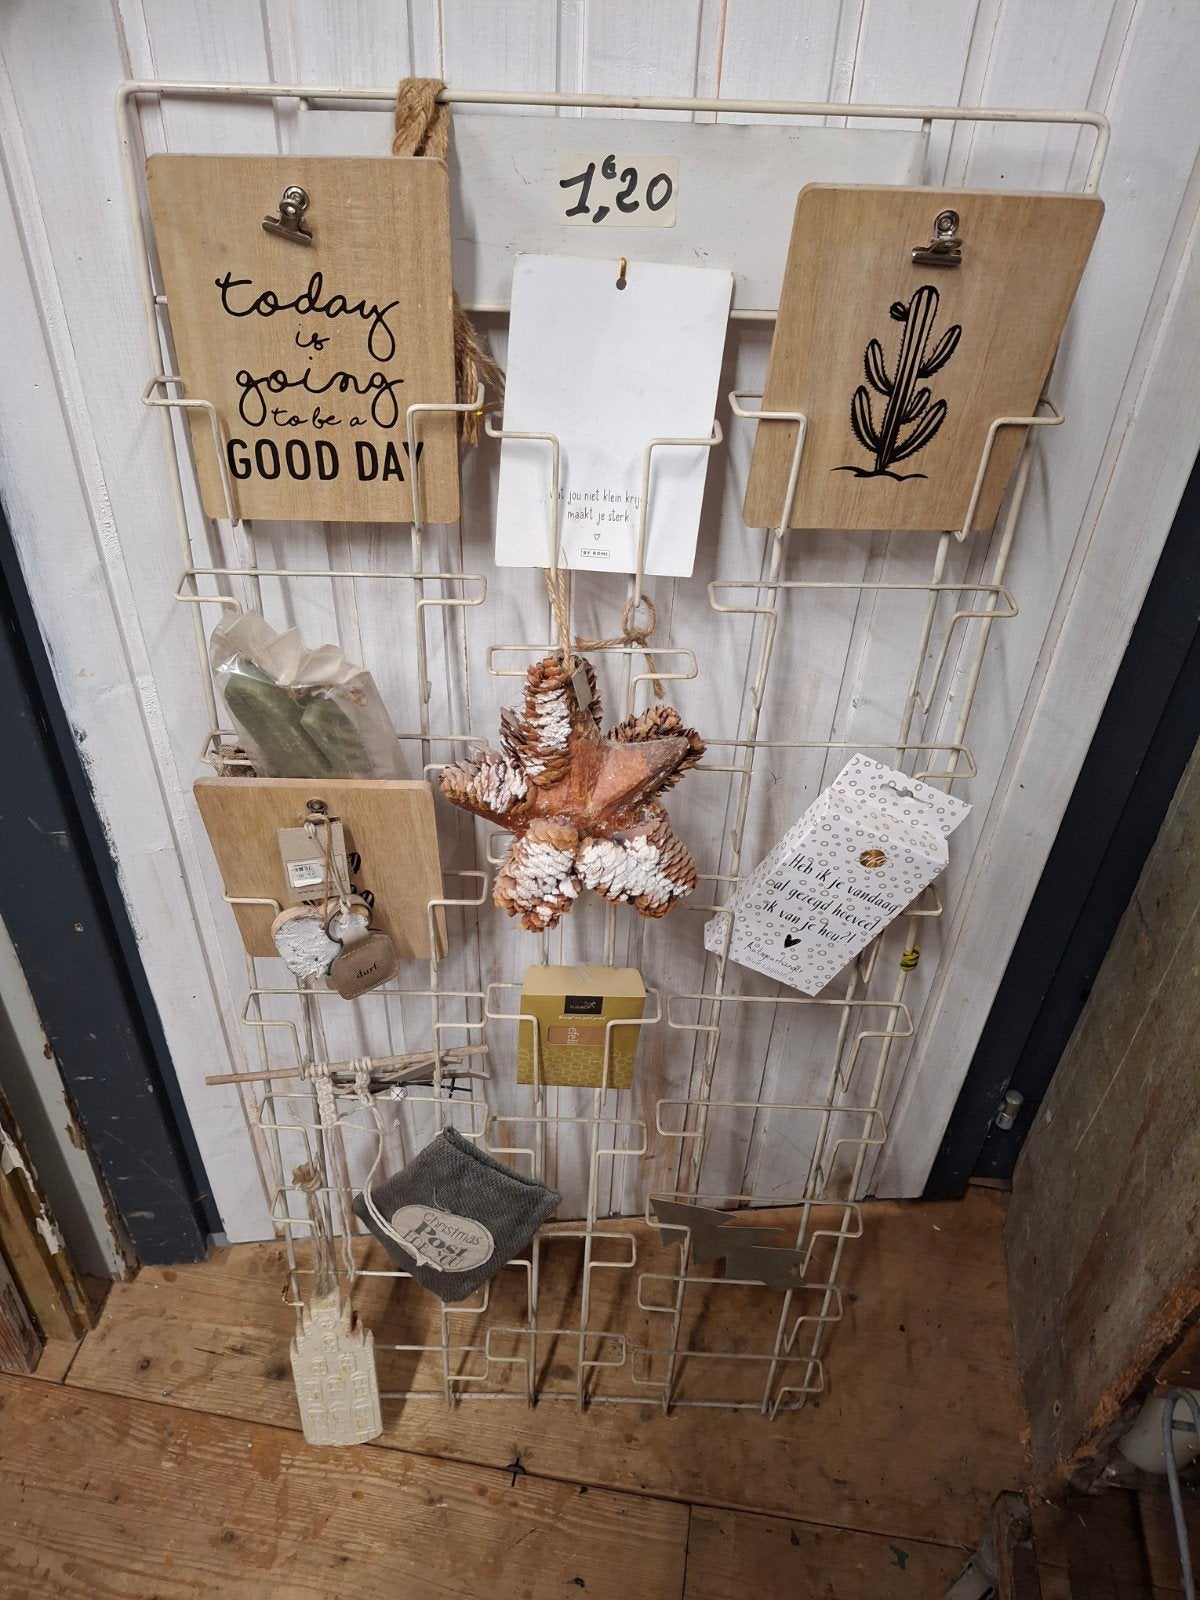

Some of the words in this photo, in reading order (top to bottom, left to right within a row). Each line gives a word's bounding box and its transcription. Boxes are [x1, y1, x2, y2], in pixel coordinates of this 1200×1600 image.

[215, 271, 400, 362] today
[295, 323, 331, 351] is
[236, 356, 404, 428] going
[271, 407, 308, 427] to
[312, 406, 342, 429] be
[350, 416, 367, 427] a
[226, 438, 340, 481] GOOD
[355, 440, 424, 482] DAY
[550, 486, 565, 500] at
[567, 489, 582, 506] jou
[584, 488, 600, 501] niet
[603, 489, 622, 503] klein
[567, 506, 593, 520] maakt
[596, 511, 606, 526] je
[608, 508, 630, 522] sterk
[788, 852, 813, 876] Heb
[815, 866, 832, 883] ik
[829, 876, 845, 889] je
[847, 883, 902, 917] vandaag
[763, 901, 779, 917] ik
[779, 909, 801, 925] van
[800, 915, 815, 931] je
[774, 879, 791, 893] al
[787, 887, 835, 913] gezegd
[832, 902, 883, 932] hoeveel
[423, 1211, 483, 1247] Christmas
